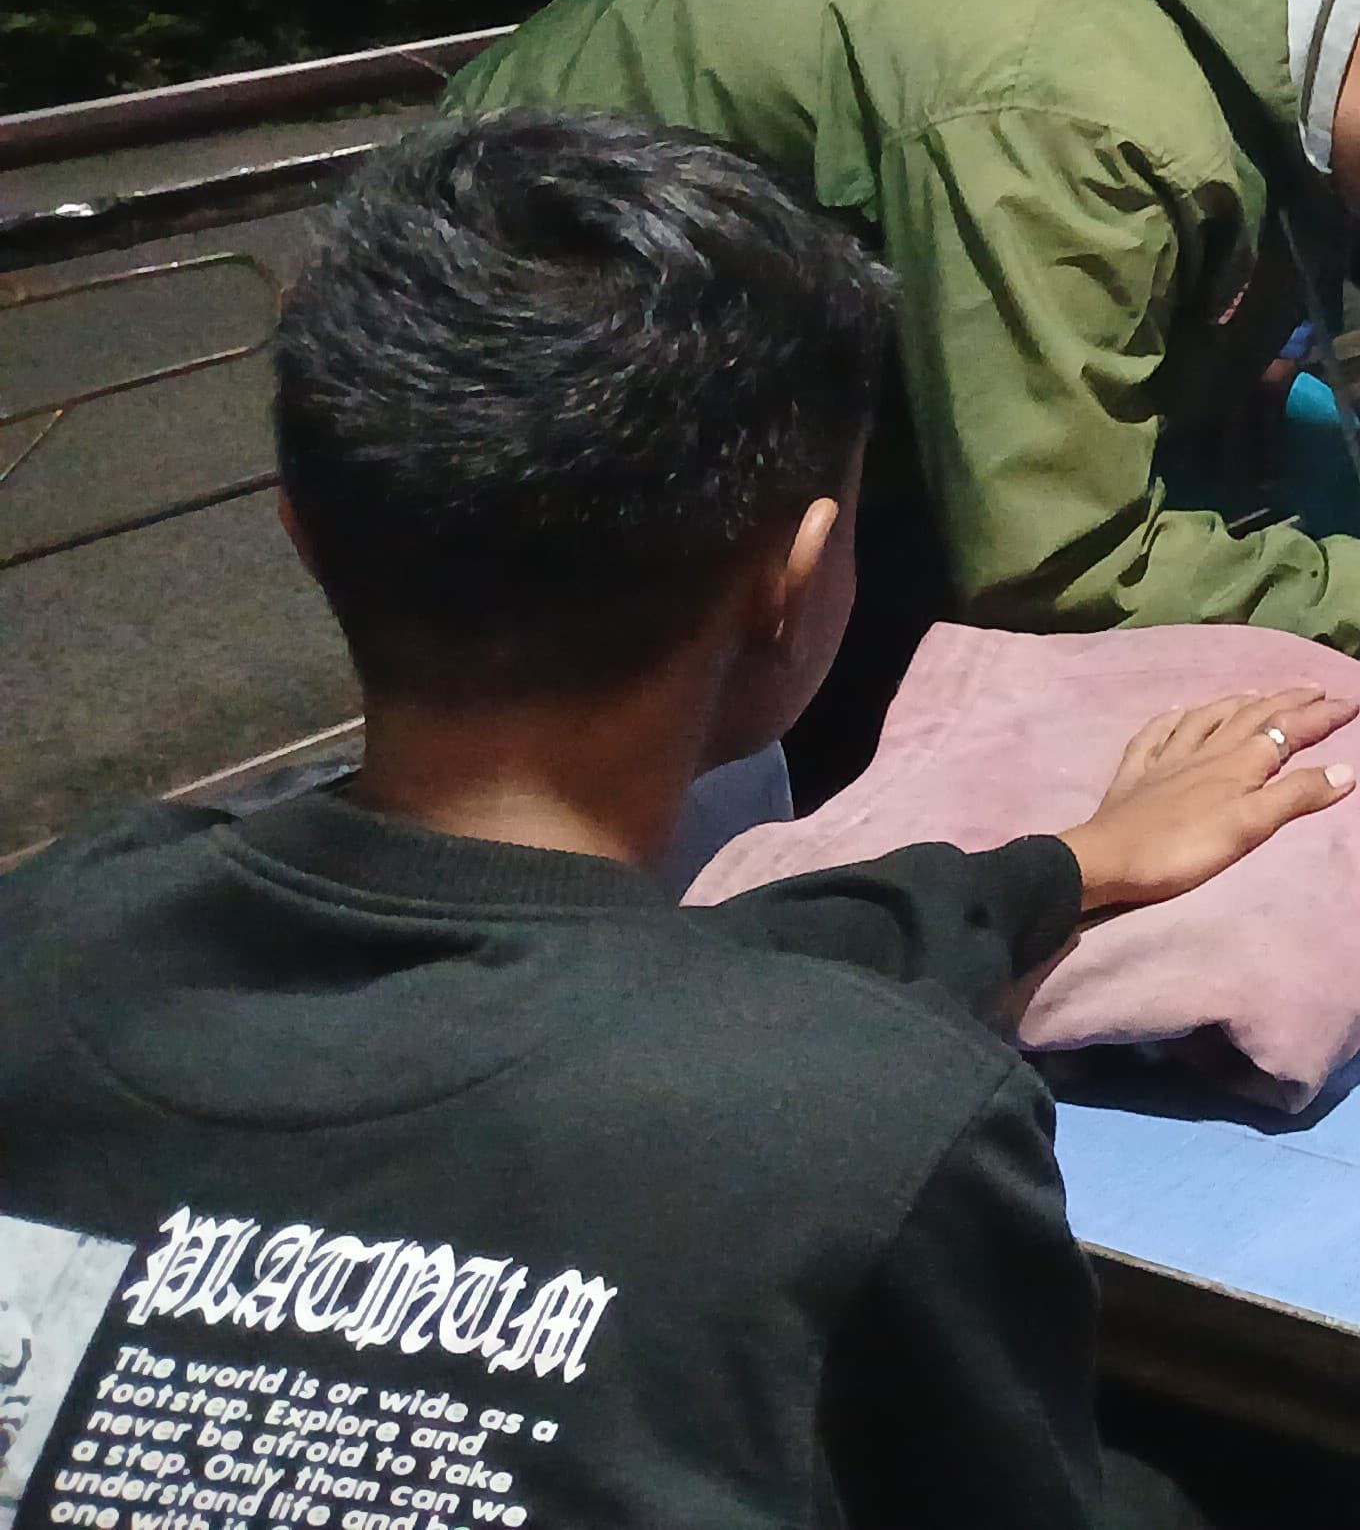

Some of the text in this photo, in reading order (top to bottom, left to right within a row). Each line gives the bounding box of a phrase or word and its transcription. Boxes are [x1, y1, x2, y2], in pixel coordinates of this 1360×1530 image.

[97, 1373, 488, 1456] footstep. Explore and
[115, 1346, 560, 1443] The world is or wide as a
[87, 1411, 192, 1443] never
[197, 1420, 243, 1451] be
[375, 1447, 416, 1476] to
[429, 1455, 513, 1493] take
[104, 1443, 190, 1479] step.
[204, 1453, 286, 1490] Only
[294, 1466, 381, 1502] than
[390, 1485, 460, 1513] can
[472, 1498, 528, 1528] we
[51, 1501, 120, 1529] one
[55, 1470, 263, 1517] understand
[268, 1492, 330, 1526] life
